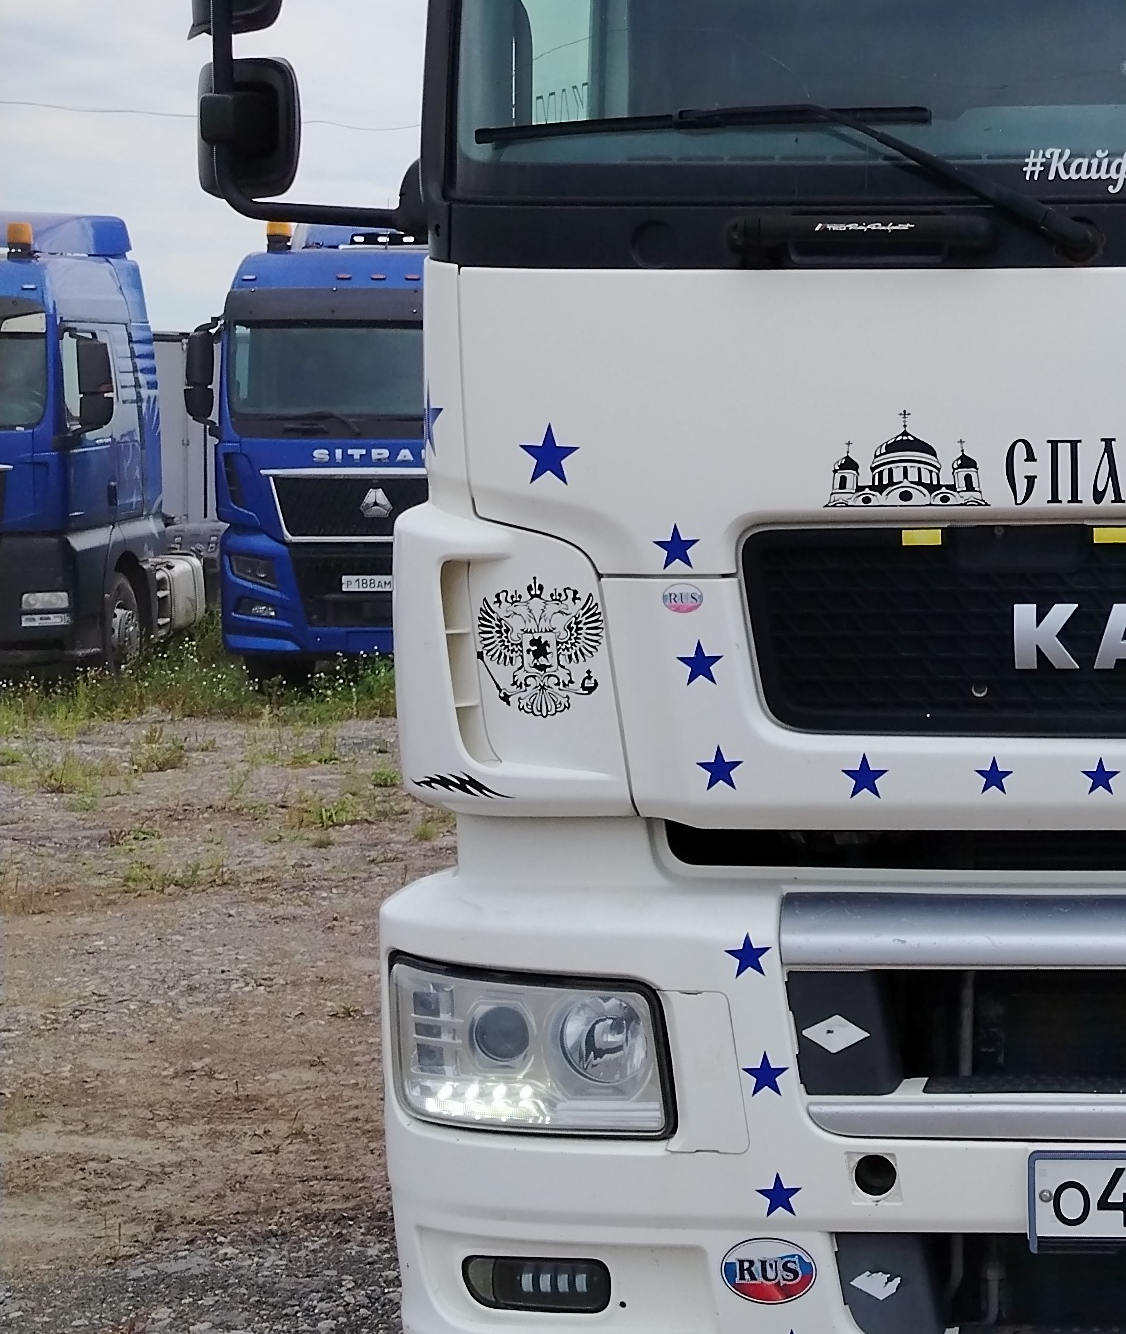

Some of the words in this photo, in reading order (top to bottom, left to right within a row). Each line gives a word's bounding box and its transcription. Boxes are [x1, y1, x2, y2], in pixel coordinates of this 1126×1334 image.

[312, 448, 425, 463] SITRA
[668, 592, 698, 604] RUS
[736, 1258, 800, 1283] RUS
